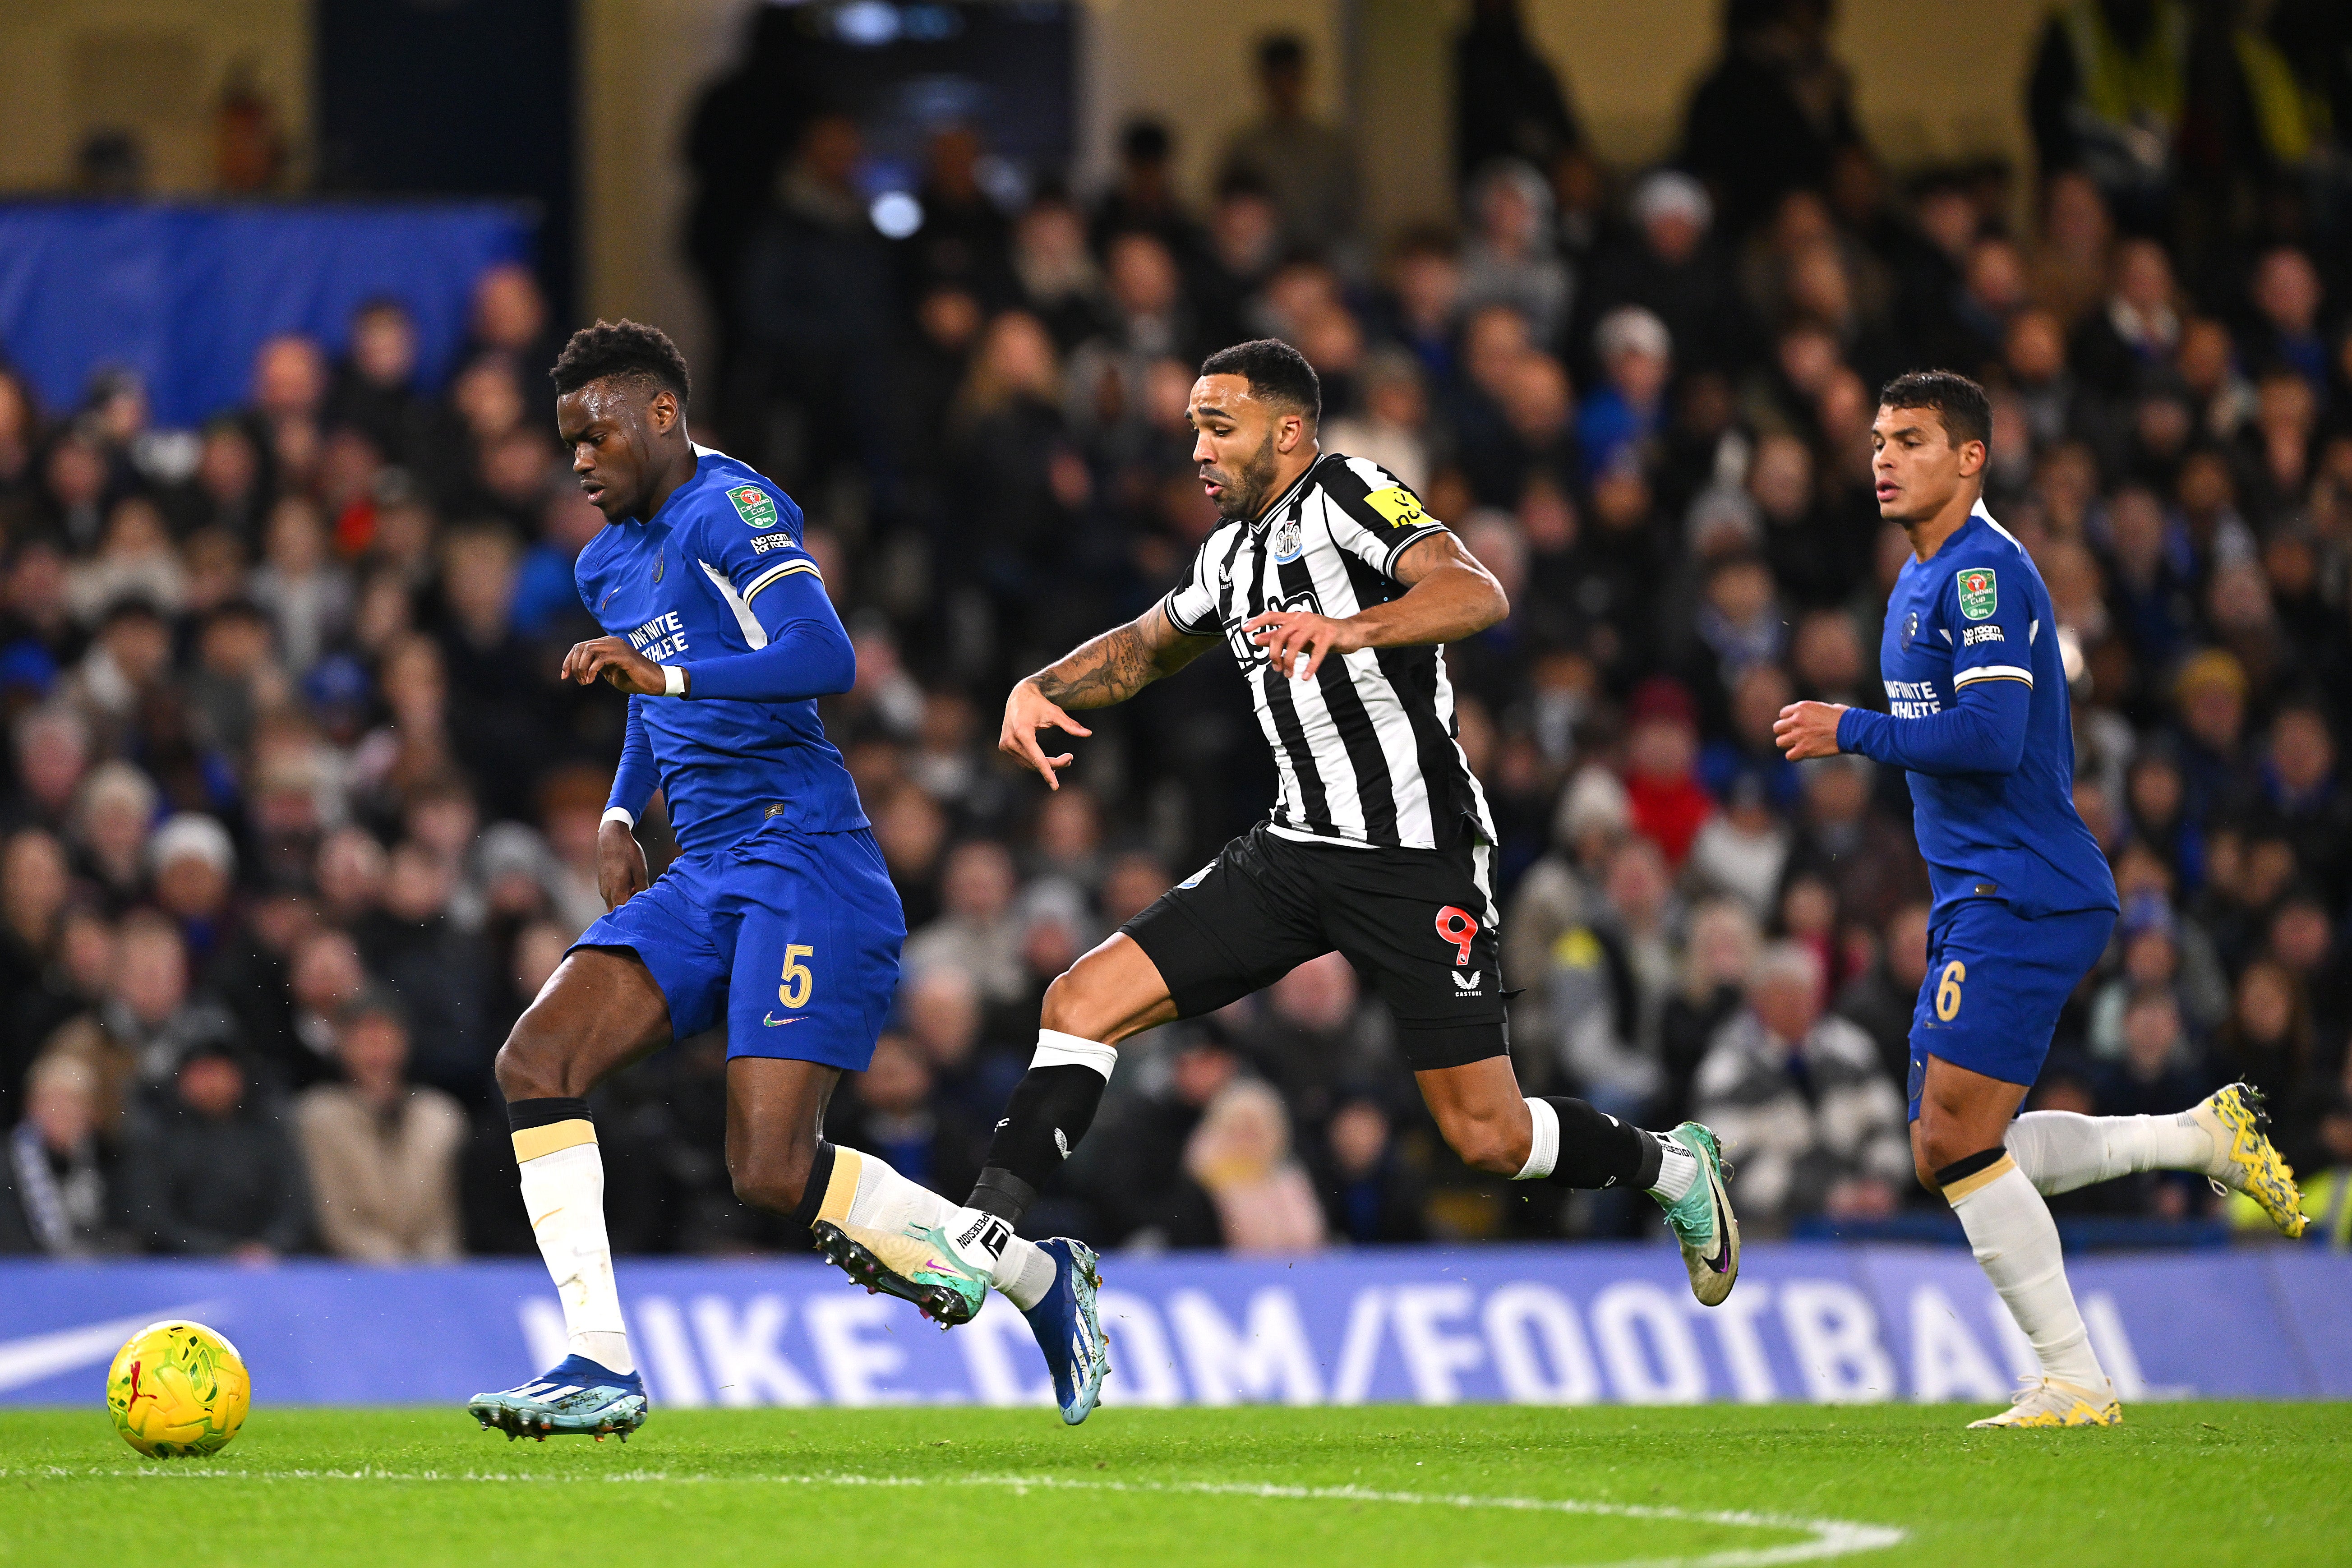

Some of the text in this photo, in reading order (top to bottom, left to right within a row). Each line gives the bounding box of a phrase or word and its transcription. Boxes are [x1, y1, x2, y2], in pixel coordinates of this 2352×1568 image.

[740, 498, 770, 513] Carabao
[751, 506, 766, 515] Cup
[750, 533, 789, 547] No room
[754, 543, 770, 555] for
[1962, 587, 1993, 602] Carabao
[1970, 596, 1986, 605] Cup
[628, 611, 683, 650] INFINITE
[1963, 625, 2000, 638] No room
[1964, 632, 2004, 647] for racism
[1435, 905, 1479, 966] 9
[779, 944, 813, 1009] 5
[1936, 960, 1966, 1022] 6
